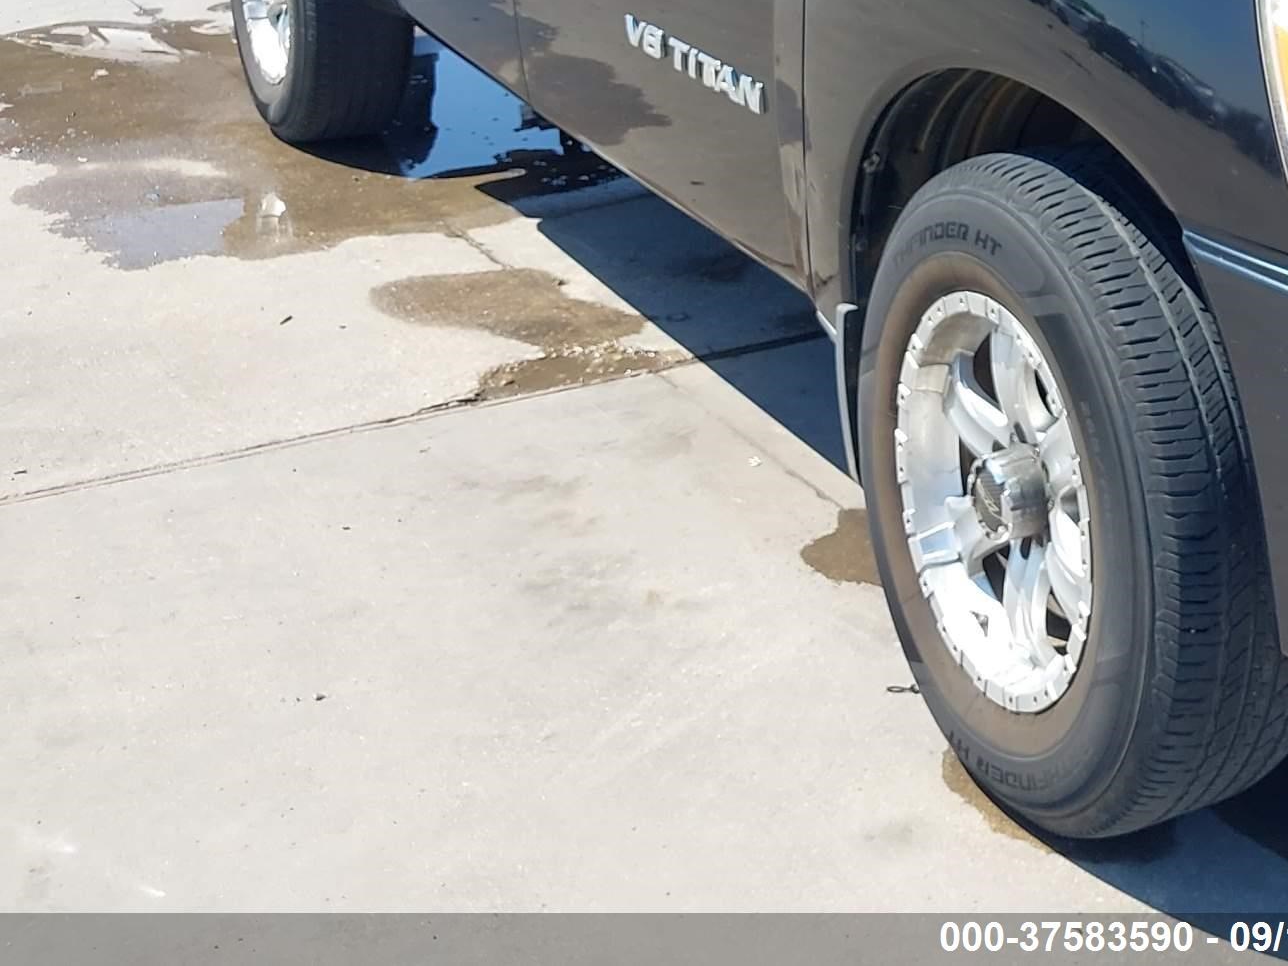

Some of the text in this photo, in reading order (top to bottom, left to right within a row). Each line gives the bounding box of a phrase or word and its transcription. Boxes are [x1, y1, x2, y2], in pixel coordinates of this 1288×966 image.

[624, 12, 766, 114] V8 TITAN
[973, 227, 1004, 257] HT
